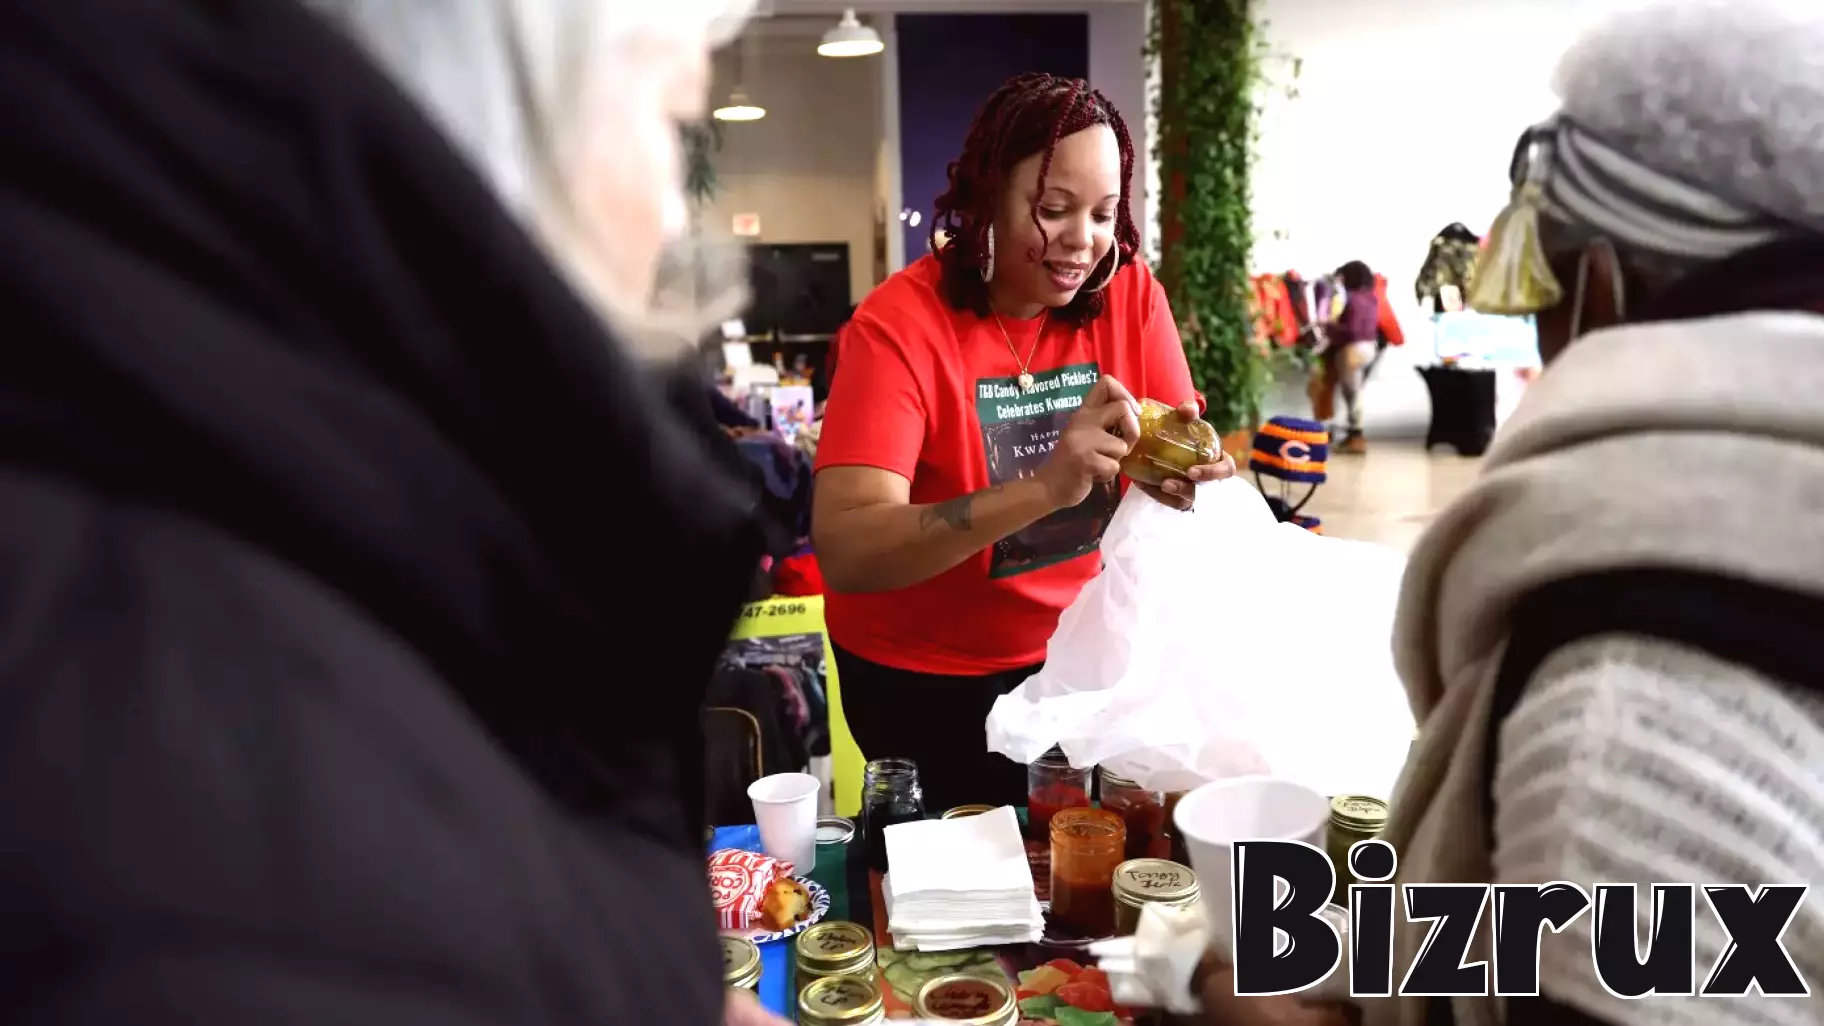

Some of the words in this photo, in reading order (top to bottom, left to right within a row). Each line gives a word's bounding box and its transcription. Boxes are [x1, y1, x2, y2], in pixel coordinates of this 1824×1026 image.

[994, 383, 1020, 400] Candy
[997, 401, 1045, 420] Celebrates
[1046, 395, 1083, 412] Kwanzaa
[1012, 439, 1059, 458] KWAN
[1279, 439, 1312, 464] C
[711, 875, 743, 889] COR
